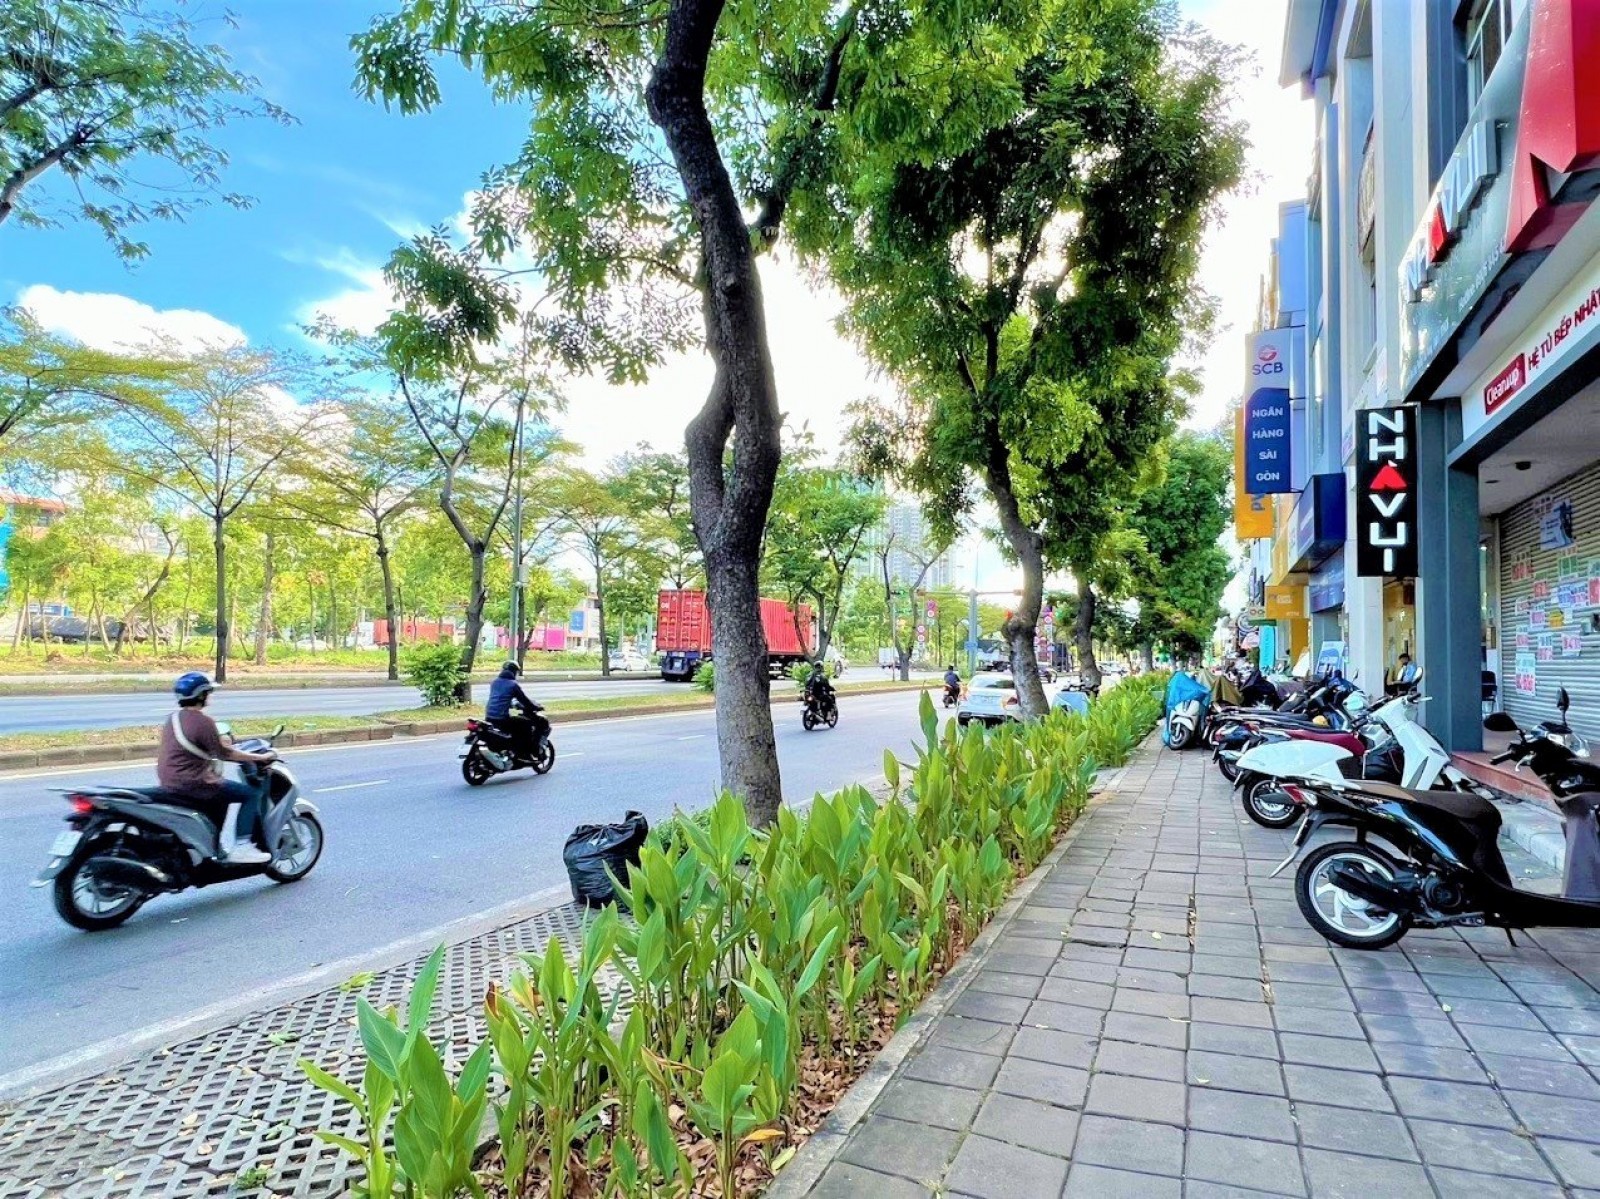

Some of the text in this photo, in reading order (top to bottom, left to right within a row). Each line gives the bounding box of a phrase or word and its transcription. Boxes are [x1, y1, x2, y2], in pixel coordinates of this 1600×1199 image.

[1528, 346, 1540, 371] HỆ
[1540, 332, 1553, 358] TỦ
[1554, 314, 1572, 347] BẾP
[1252, 361, 1284, 376] SCB
[1486, 367, 1520, 406] Cleanup
[1252, 406, 1284, 419] NGÂN
[1252, 428, 1284, 440] HÀNG
[1258, 449, 1277, 460] SÀI
[1255, 469, 1280, 481] GÒN
